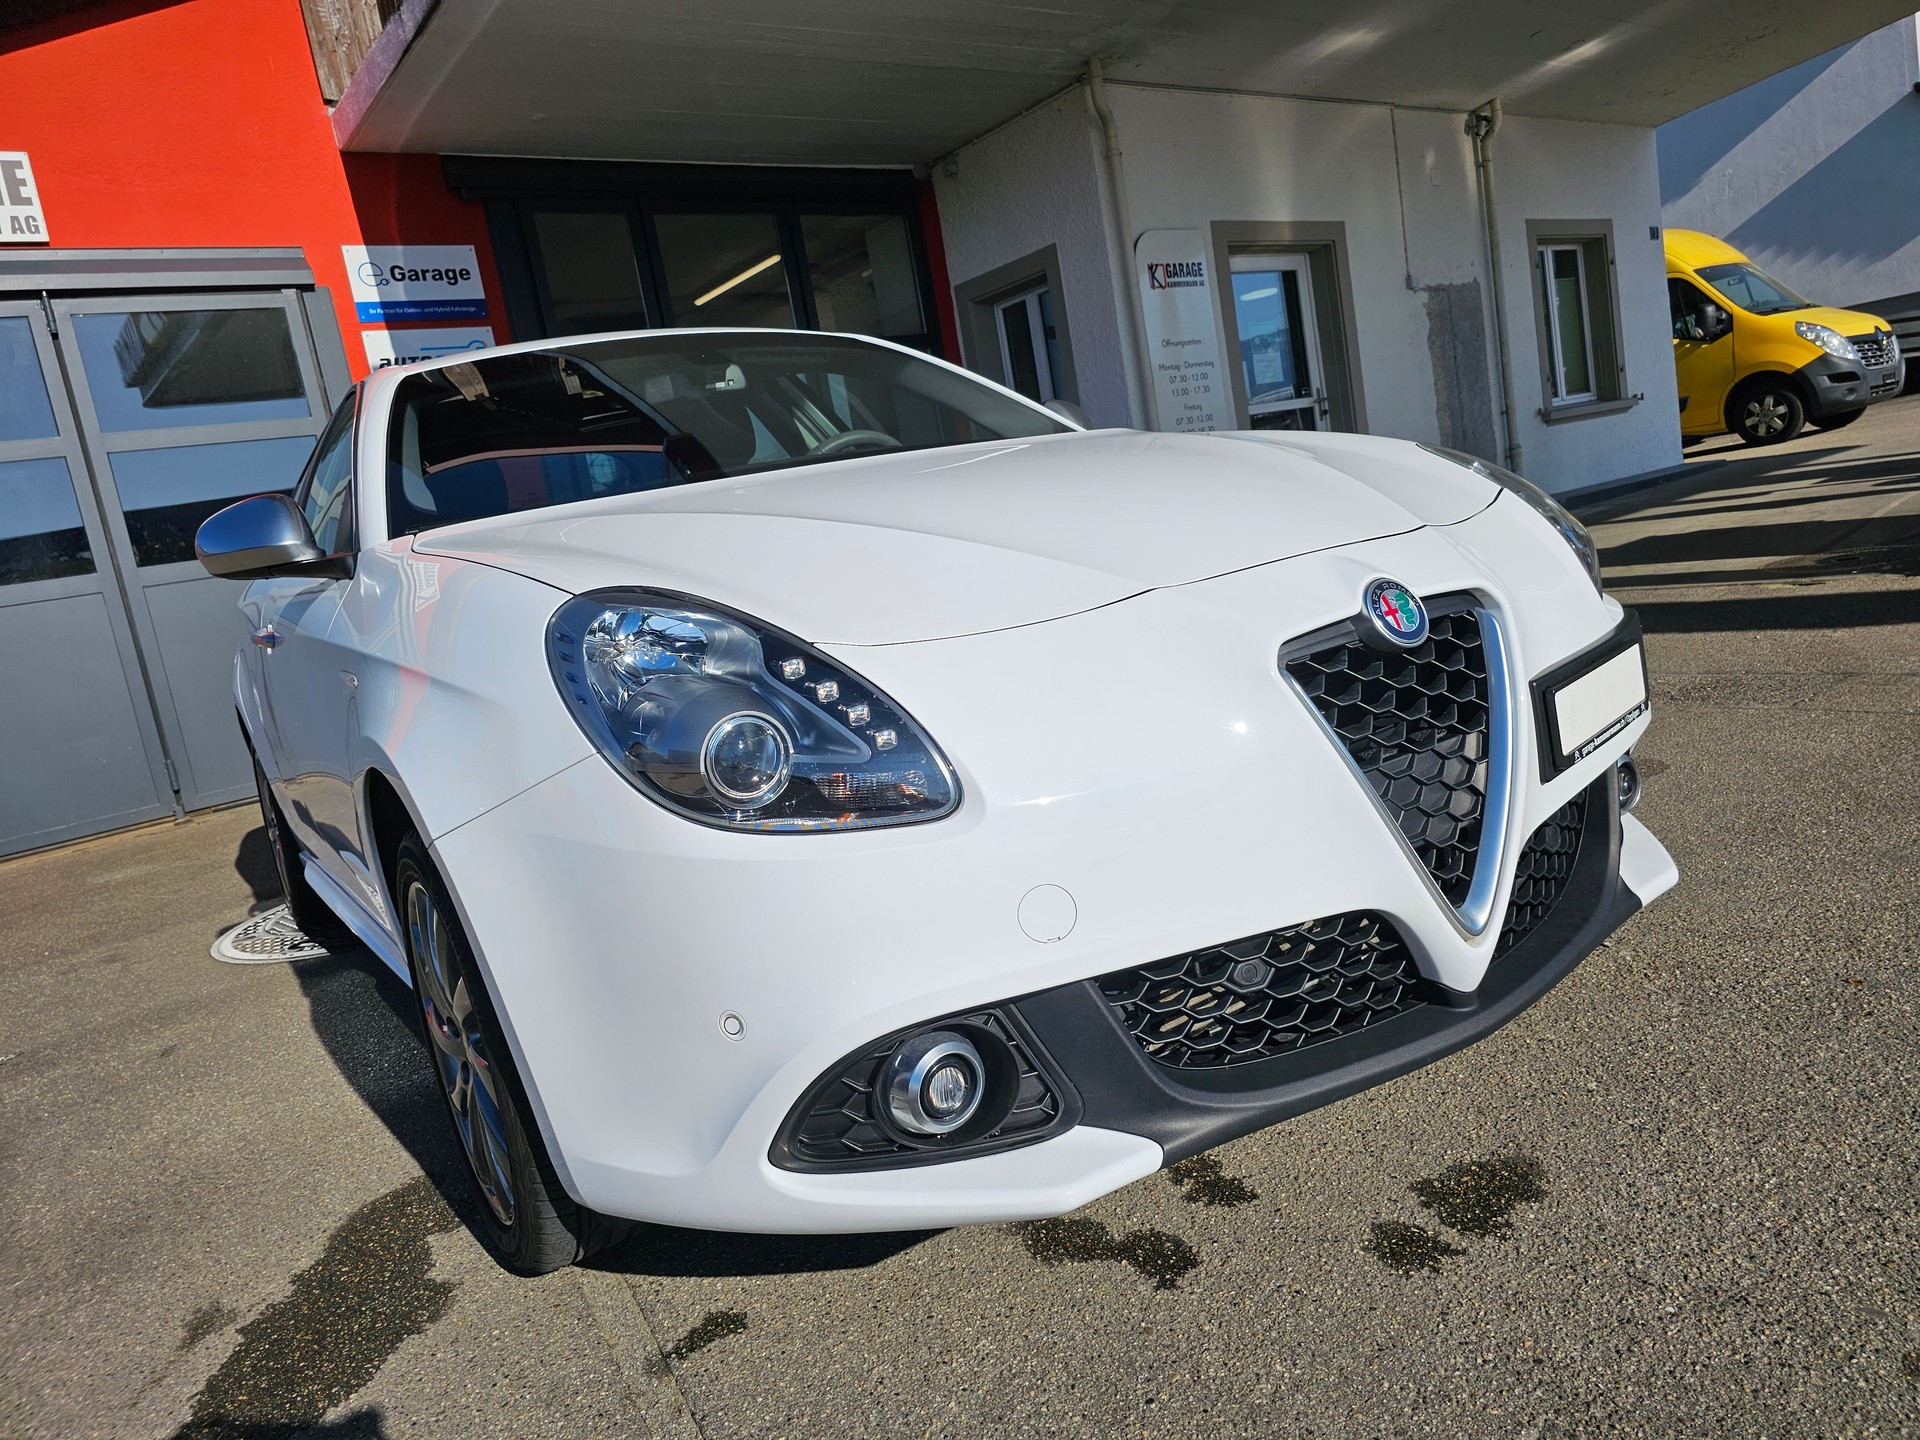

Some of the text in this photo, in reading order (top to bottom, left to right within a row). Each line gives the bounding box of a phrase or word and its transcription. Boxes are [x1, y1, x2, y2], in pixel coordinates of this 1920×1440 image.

[0, 160, 34, 206] E
[10, 215, 41, 235] AG
[390, 265, 472, 286] Garage
[1165, 262, 1204, 278] GARAGE
[1158, 363, 1181, 372] Montag
[1184, 360, 1215, 369] Donnerstag
[1169, 374, 1187, 384] 07.30
[1191, 372, 1209, 381] 12.00
[1172, 387, 1189, 397] 13.00
[1193, 385, 1210, 394] 17.30
[1184, 403, 1203, 411] Freitag
[1175, 416, 1194, 426] 07.30
[1197, 413, 1214, 423] 12.00
[1372, 582, 1419, 616] ALFA ROMEO
